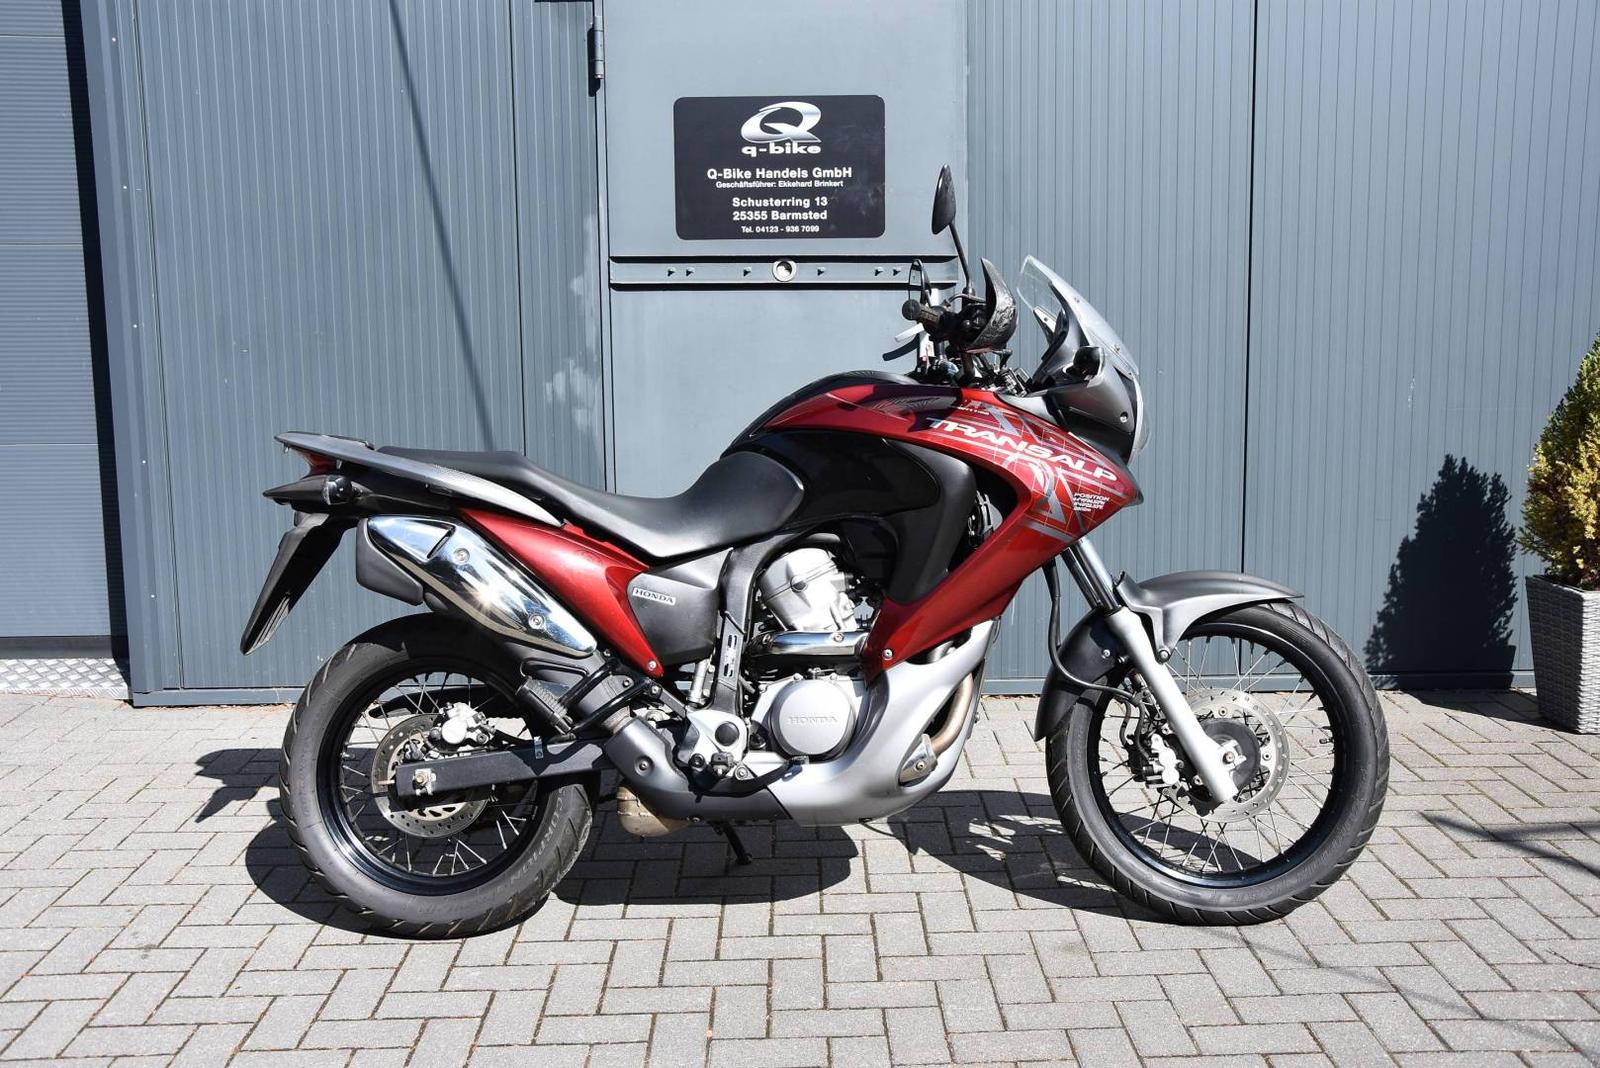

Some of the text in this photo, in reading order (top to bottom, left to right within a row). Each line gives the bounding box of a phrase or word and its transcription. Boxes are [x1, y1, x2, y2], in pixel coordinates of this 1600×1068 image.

[741, 142, 822, 157] q-bike
[707, 167, 852, 180] Q-Bike Handels GmbH
[716, 180, 843, 189] Geschäftsführer: Ekkehard Brinkert
[732, 196, 828, 208] Schusterring 13
[732, 210, 828, 221] 25355 Barmsted
[926, 416, 1118, 482] TRANSALP
[635, 589, 674, 603] HONDA
